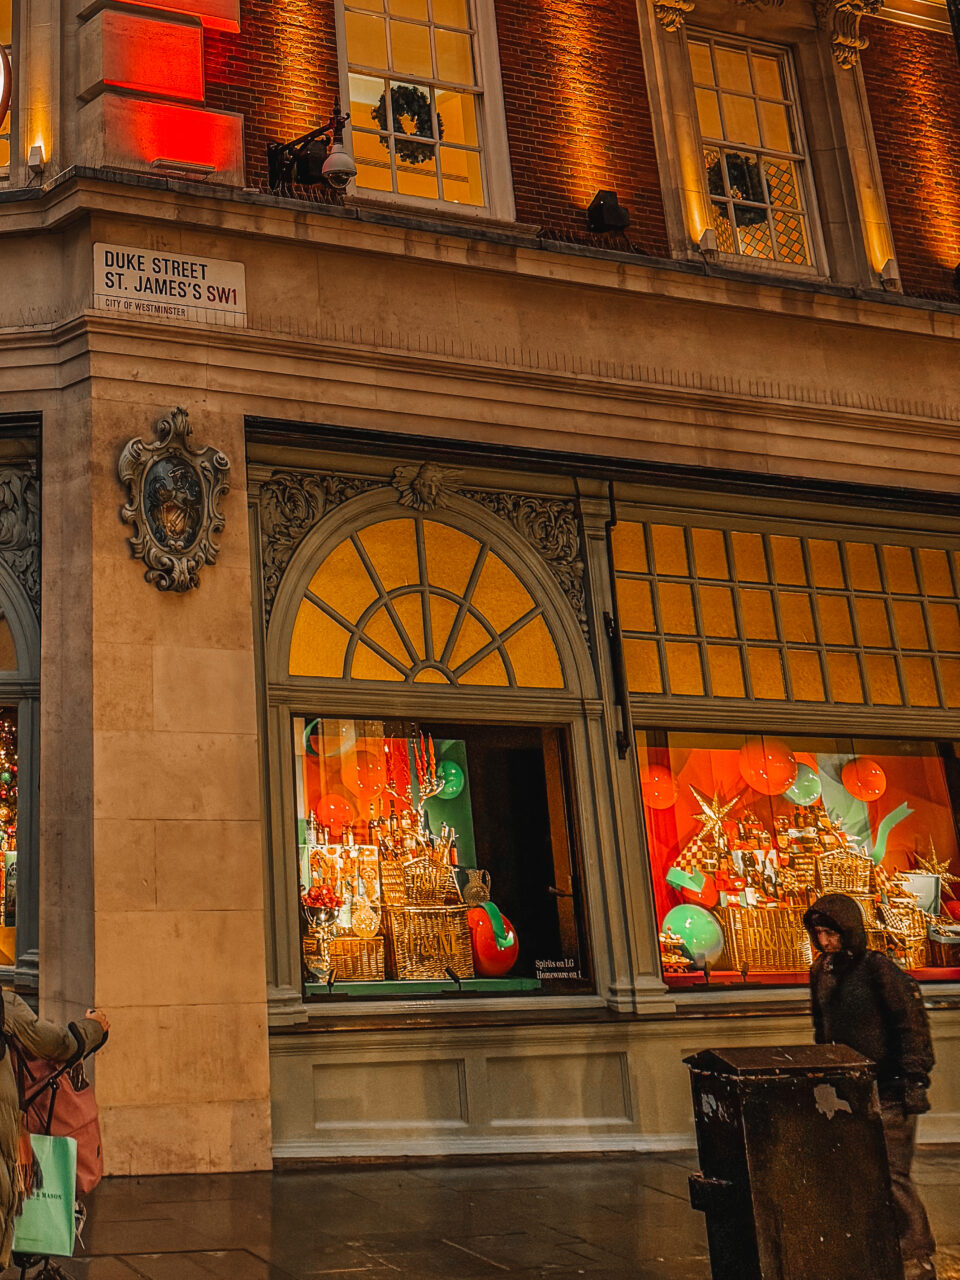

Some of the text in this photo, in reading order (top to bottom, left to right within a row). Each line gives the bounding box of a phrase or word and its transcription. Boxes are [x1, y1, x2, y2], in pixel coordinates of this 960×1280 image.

[104, 250, 208, 280] DUKE STREET
[105, 271, 237, 305] ST. JAMES'S SW1
[105, 298, 186, 317] CITY OF WESTMINSTER
[535, 959, 556, 969] Spirits
[536, 970, 569, 979] Homeware
